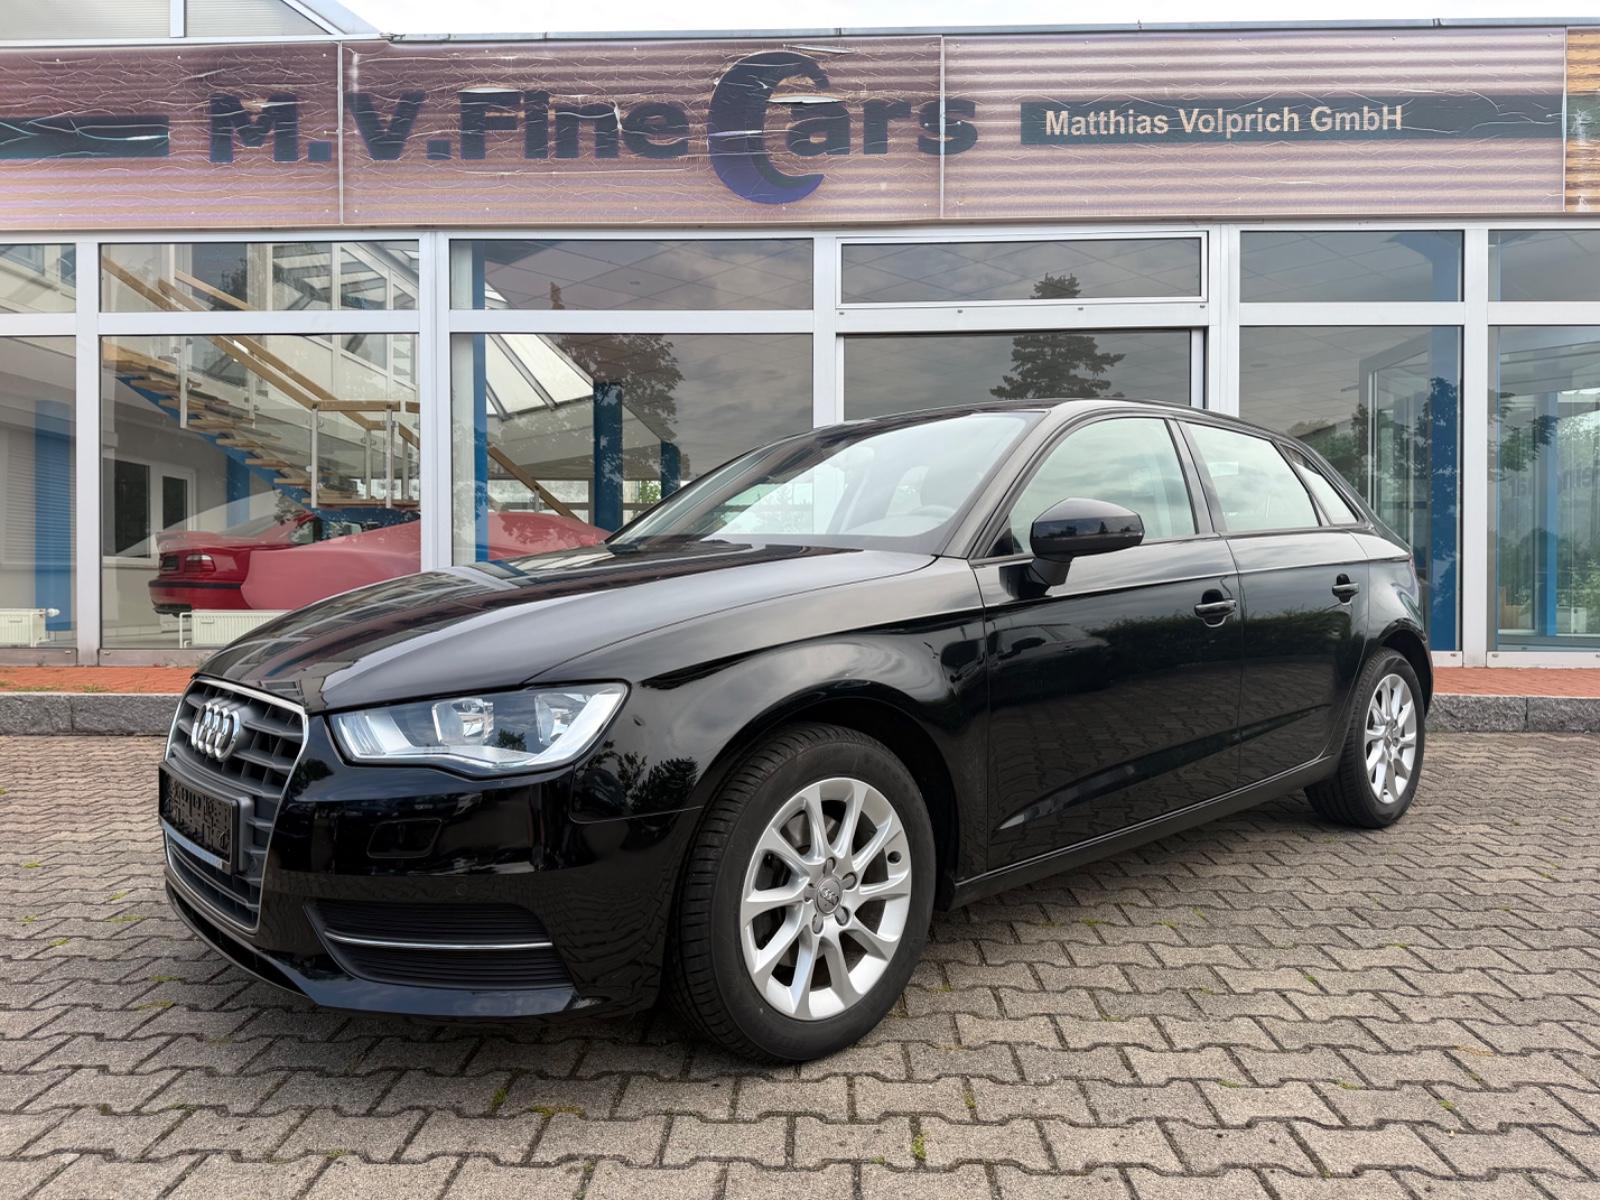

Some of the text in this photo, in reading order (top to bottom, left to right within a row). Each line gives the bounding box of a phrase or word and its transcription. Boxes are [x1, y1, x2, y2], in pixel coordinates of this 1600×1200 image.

[707, 51, 978, 205] Cars
[1045, 104, 1403, 139] Matthias Volprich GmbH
